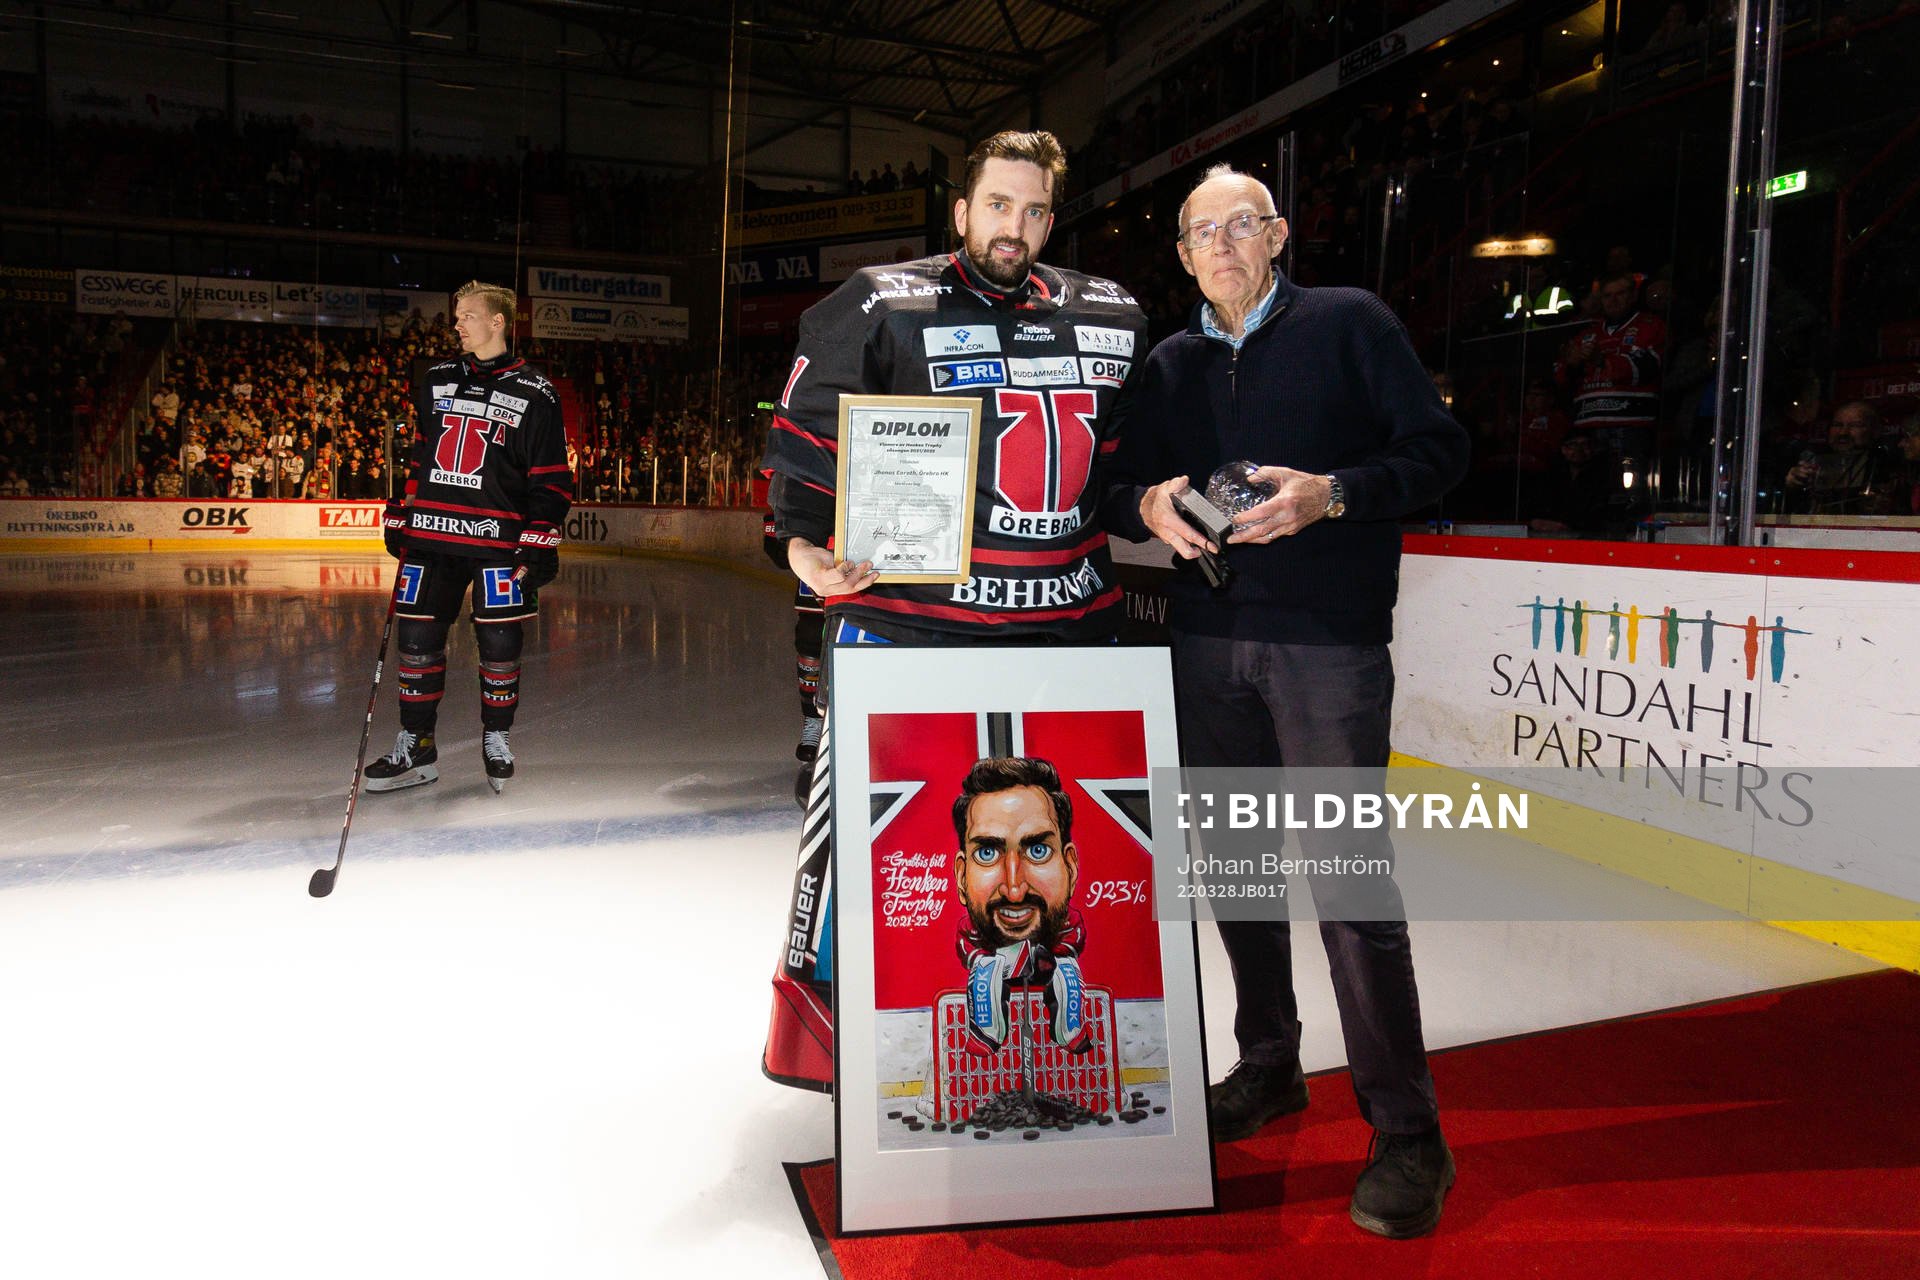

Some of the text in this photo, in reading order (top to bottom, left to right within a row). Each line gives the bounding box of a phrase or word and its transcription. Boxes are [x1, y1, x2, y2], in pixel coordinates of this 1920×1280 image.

[1171, 111, 1260, 168] ICA Supermarket
[775, 256, 813, 281] NA
[831, 253, 893, 270] Swedbank
[728, 261, 765, 285] NA
[81, 275, 168, 296] ESSWEGE
[537, 270, 662, 299] Vintergatan
[181, 286, 268, 304] HERCULES
[861, 284, 953, 315] NÄRKE KÖTT
[154, 300, 170, 310] AB
[944, 343, 984, 353] INFRA-CON
[1080, 330, 1133, 349] NASTA
[956, 363, 1002, 381] BRL
[1012, 368, 1070, 379] RUDDAMMENS
[1091, 360, 1128, 379] OBK
[516, 377, 542, 391] NÄRKE
[494, 391, 526, 409] NASTA
[493, 407, 516, 423] OBK
[492, 423, 506, 446] A
[871, 421, 951, 437] DIPLOM
[434, 472, 478, 487] ÖREBRO
[46, 508, 97, 521] ÖREBRO
[182, 507, 250, 526] OBK
[324, 508, 376, 526] TAM
[412, 512, 475, 536] BEHRN
[999, 510, 1078, 536] ÖREBRO
[7, 519, 135, 533] FLYTTNINGSBYRÅ AB
[949, 570, 1083, 609] BEHRN
[1489, 653, 1773, 748] SANDAHL
[1513, 713, 1814, 827] PARTNERS
[882, 850, 947, 868] Grattis till
[880, 866, 949, 894] Honken
[1085, 879, 1148, 908] .923%
[881, 890, 946, 920] Trophy
[788, 872, 818, 969] BAUER
[885, 915, 929, 927] 2021-22
[976, 970, 989, 1024] HEROK
[1063, 966, 1080, 1023] HEROK
